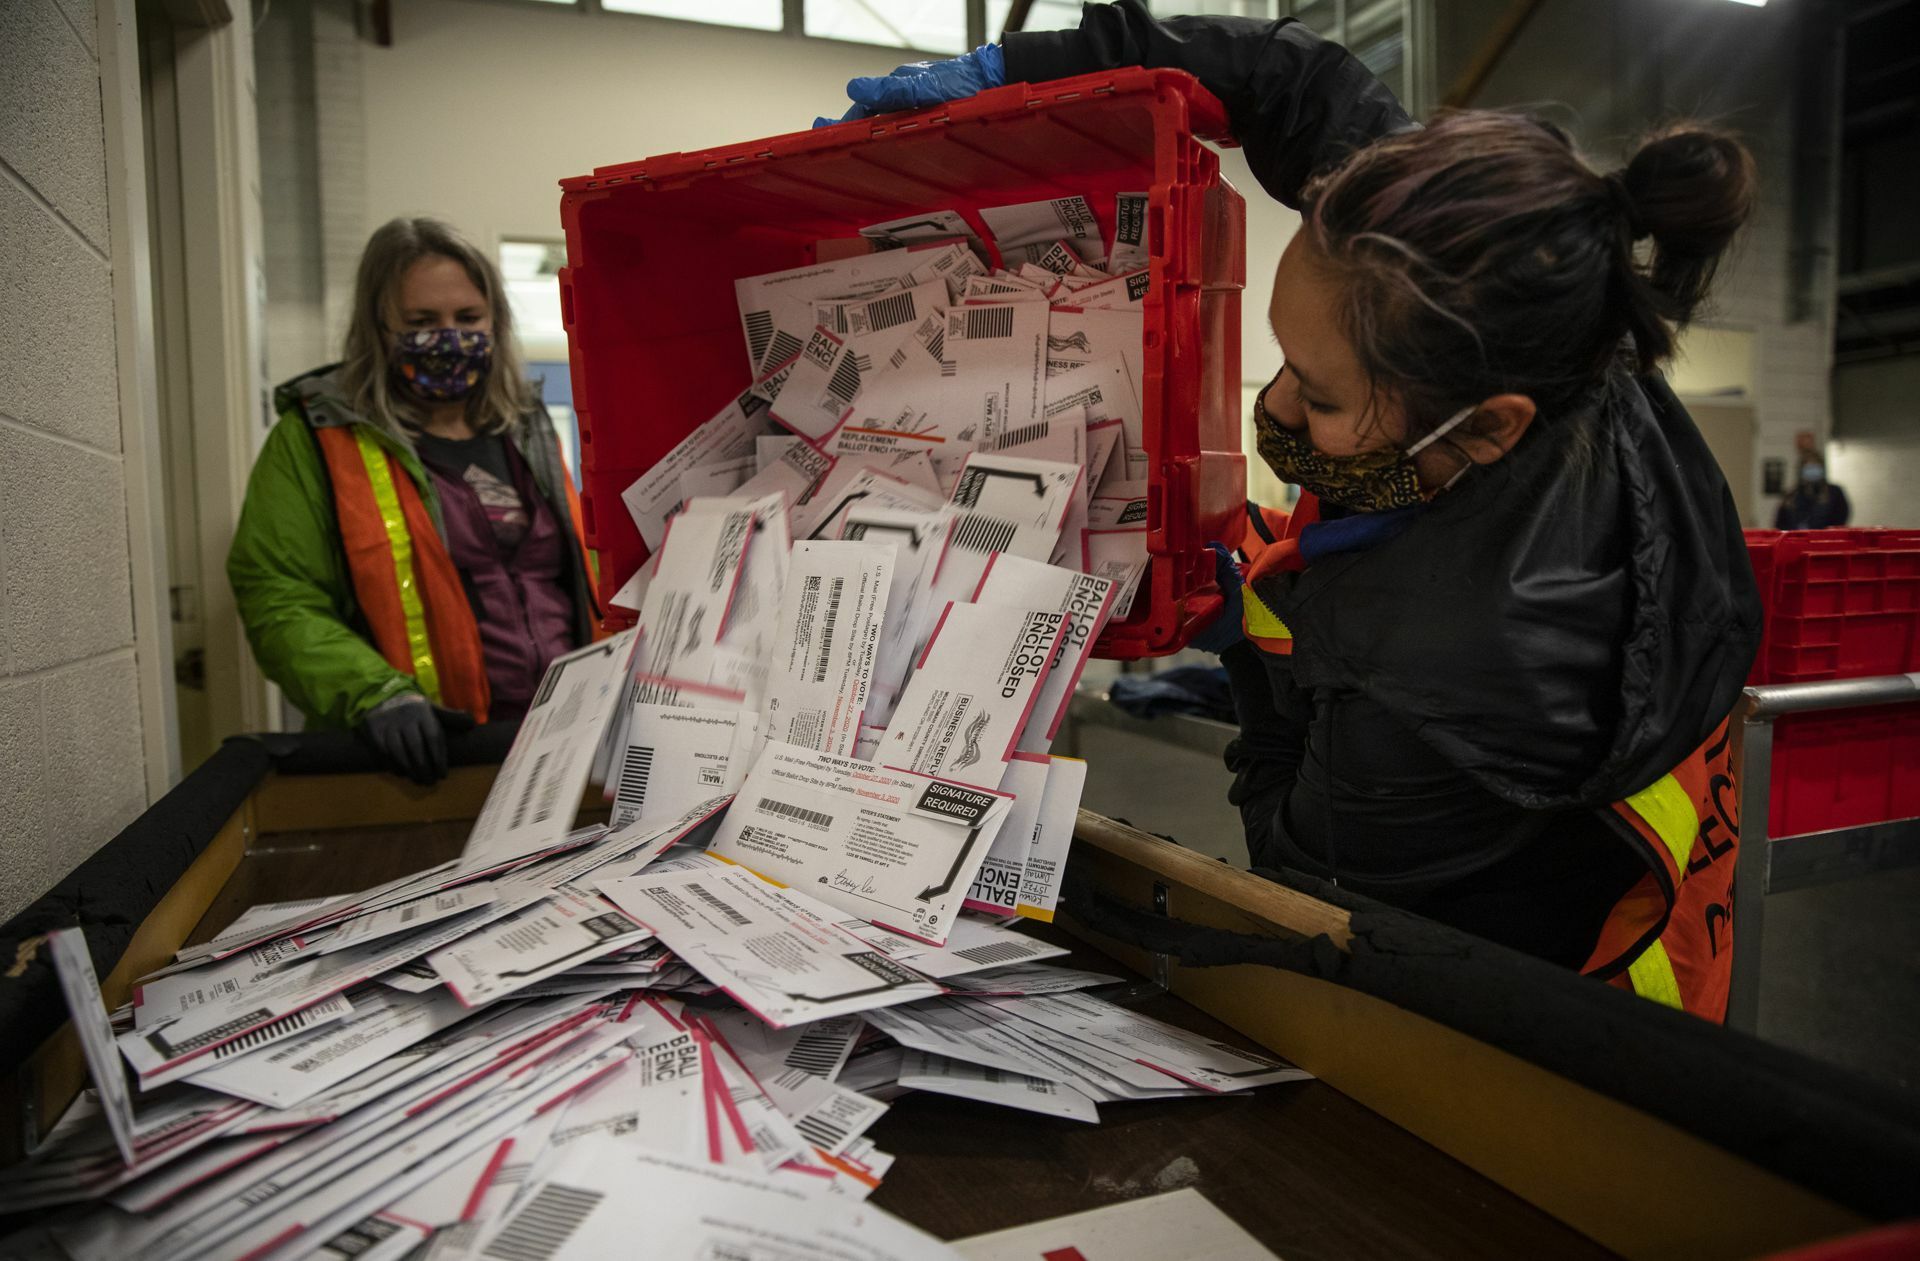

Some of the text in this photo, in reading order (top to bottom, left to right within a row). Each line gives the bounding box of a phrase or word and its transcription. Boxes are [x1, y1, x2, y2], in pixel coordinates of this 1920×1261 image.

[1052, 245, 1076, 272] BAL
[811, 331, 840, 357] BALL
[1048, 360, 1069, 369] NESS
[837, 441, 867, 453] BALLOT
[840, 432, 899, 446] REPLACEMENT
[856, 594, 864, 612] Ballot
[1070, 579, 1109, 650] BALLOT
[852, 613, 860, 629] Drop
[849, 629, 857, 641] Site
[1026, 614, 1063, 677] BALLOT
[857, 624, 878, 705] TWO WAYS TO VOTE:
[1002, 612, 1049, 698] ENCLOSED
[851, 679, 860, 704] October
[928, 697, 970, 776] BUSINESS REPLY
[817, 755, 831, 764] TWO
[831, 757, 849, 768] WAYS
[859, 764, 877, 773] VOTE:
[910, 746, 924, 772] DIRECTO
[702, 773, 721, 784] MAIL
[923, 796, 979, 818] REQUIRED
[929, 784, 991, 807] SIGNATURE
[980, 866, 1021, 889] ENCL
[968, 883, 1017, 906] BALL
